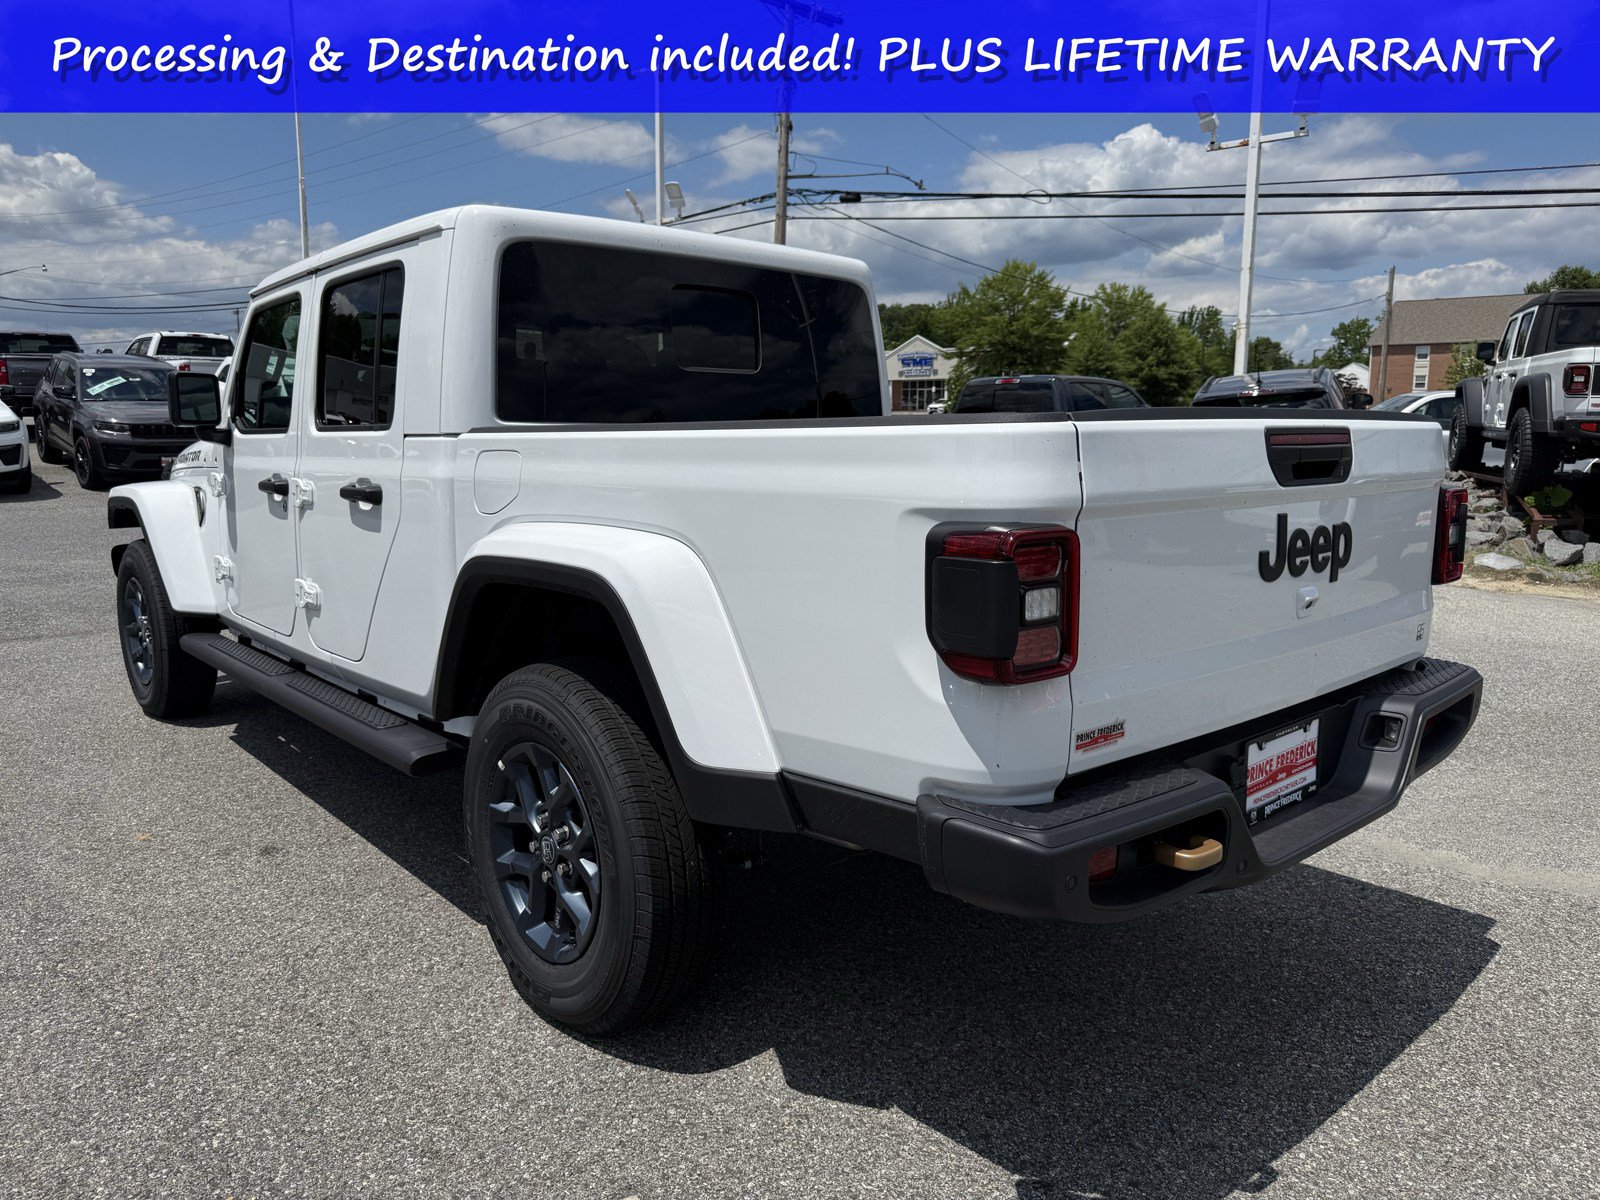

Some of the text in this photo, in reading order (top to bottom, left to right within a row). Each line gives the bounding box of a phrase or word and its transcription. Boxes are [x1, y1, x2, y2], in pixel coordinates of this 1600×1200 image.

[1258, 512, 1353, 583] Jeep
[1076, 730, 1096, 743] PRINCE
[1097, 721, 1125, 736] FREDERICK
[1246, 739, 1317, 783] PRINCE FREDERICK
[1264, 800, 1281, 819] PRINCE
